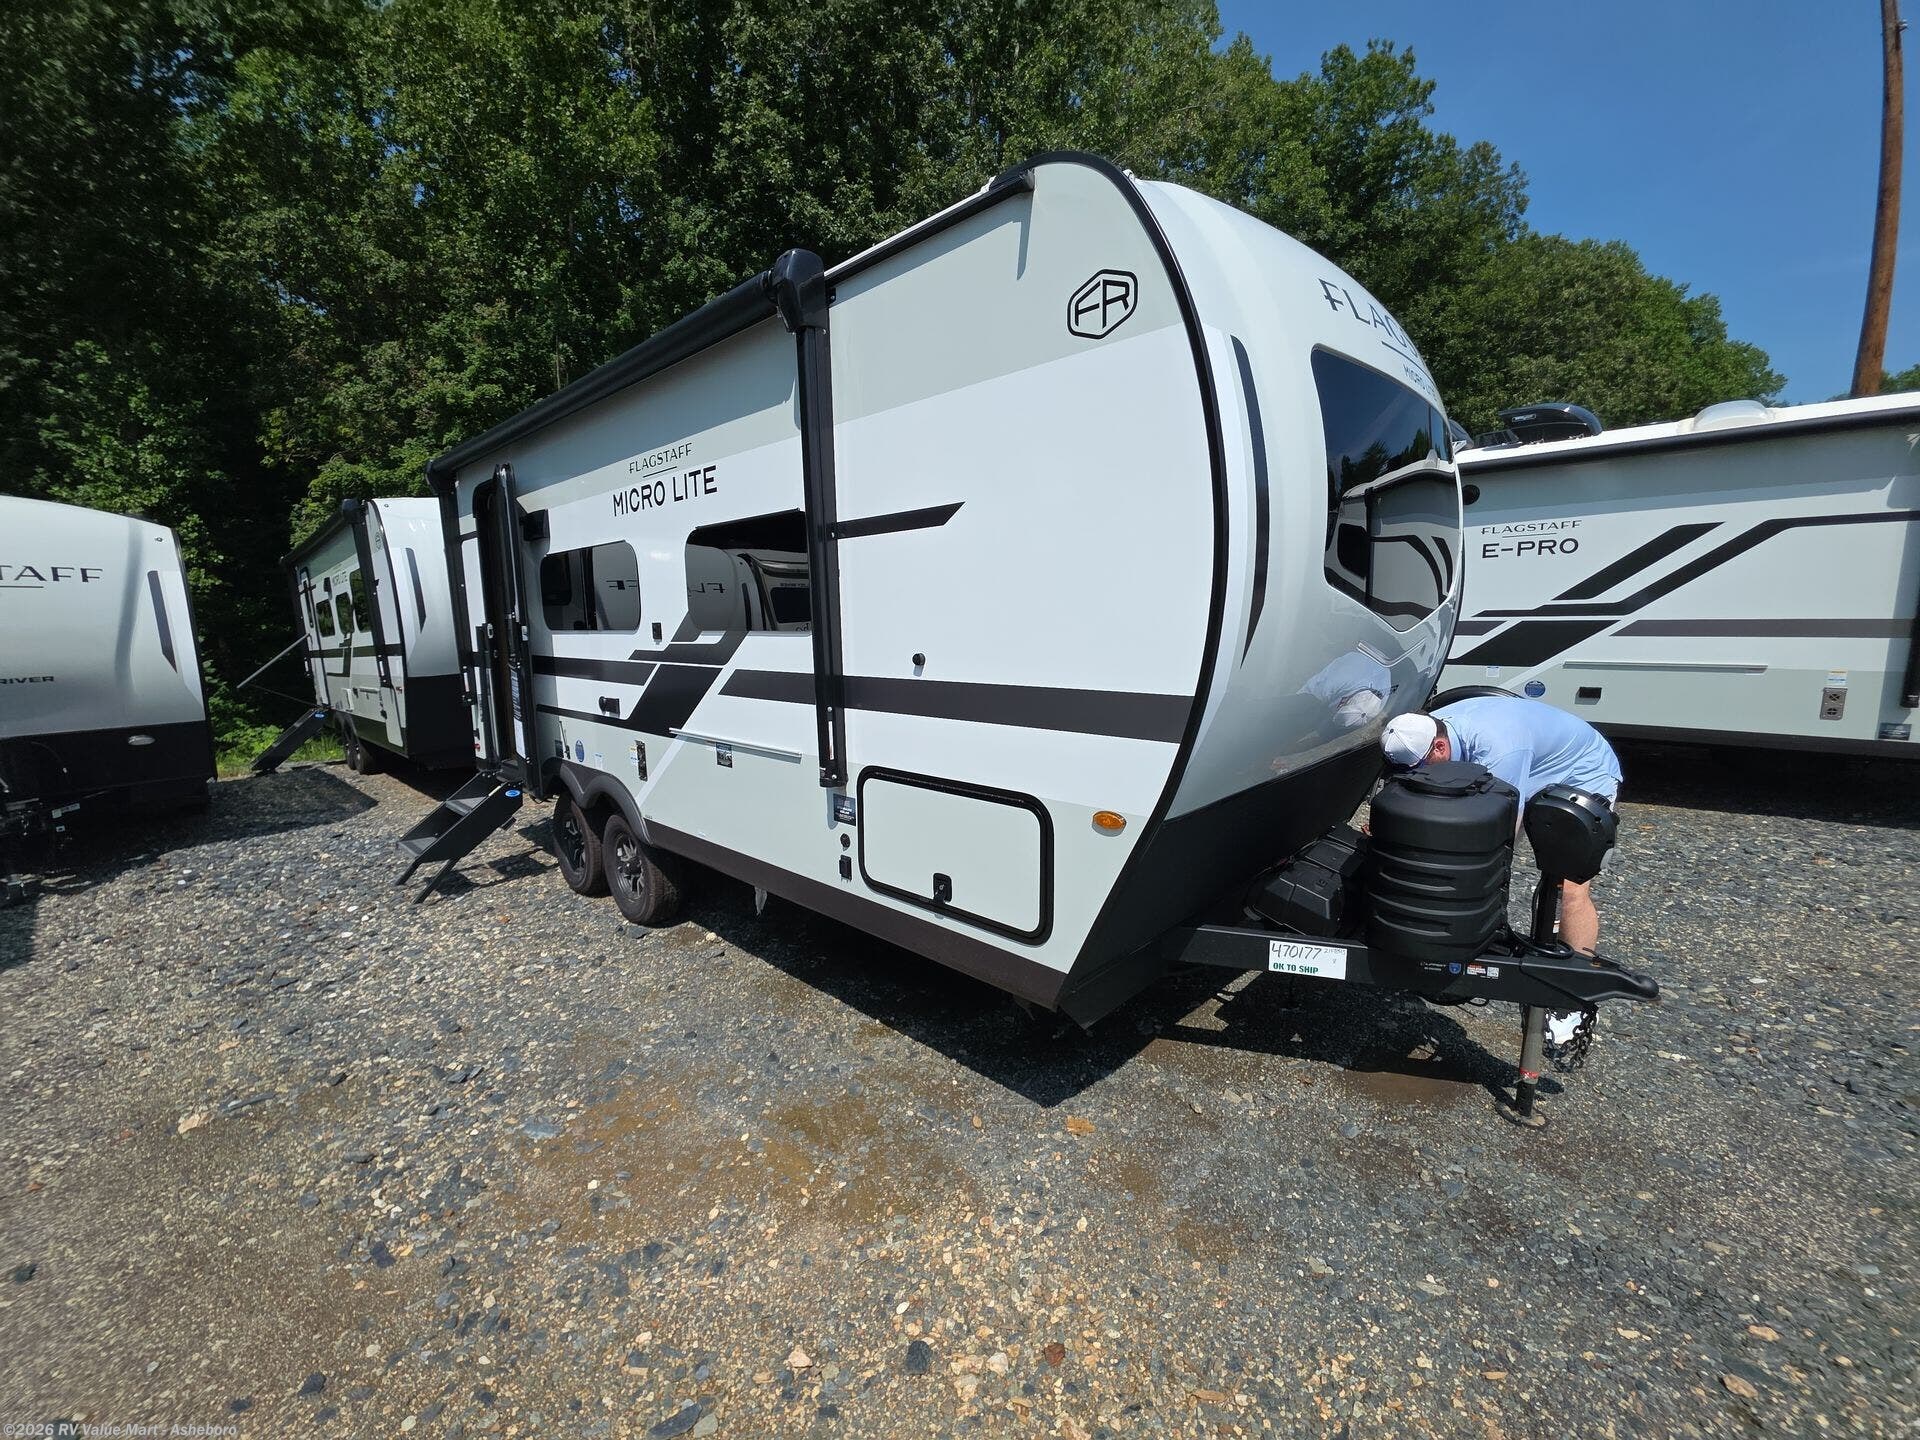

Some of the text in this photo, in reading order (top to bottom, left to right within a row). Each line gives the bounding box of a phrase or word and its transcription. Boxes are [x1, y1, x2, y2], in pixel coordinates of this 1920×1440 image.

[628, 442, 692, 474] FLAGSTAFF
[613, 465, 718, 517] MICRO LITE
[1481, 520, 1582, 534] FLAGSTAFF
[1482, 538, 1579, 558] E-PRO
[0, 676, 54, 685] RIVER
[1271, 943, 1321, 960] 470177
[1273, 962, 1318, 974] OK TO SHIP
